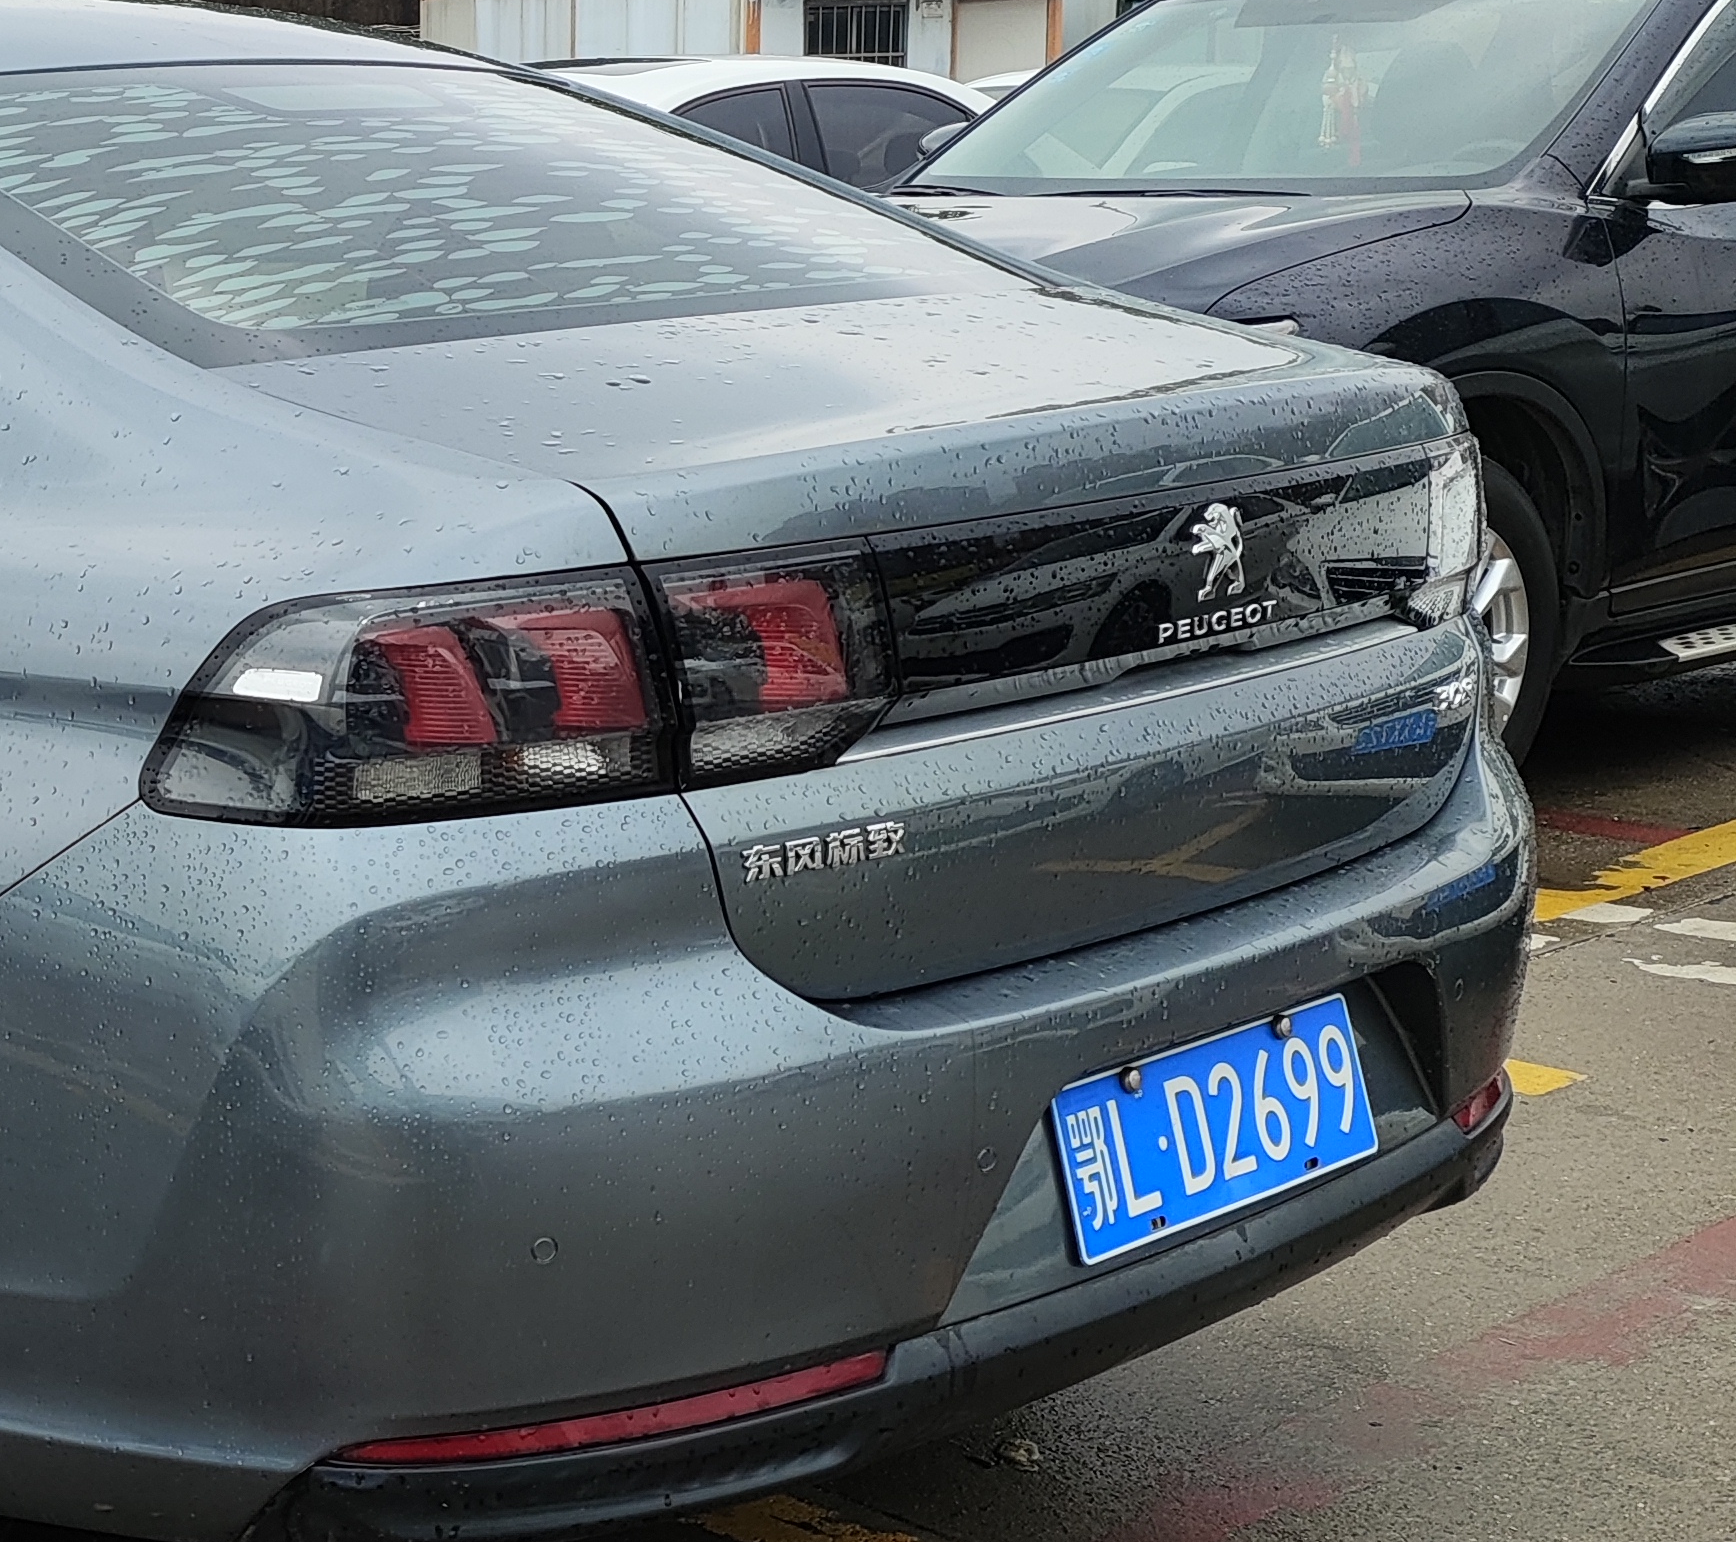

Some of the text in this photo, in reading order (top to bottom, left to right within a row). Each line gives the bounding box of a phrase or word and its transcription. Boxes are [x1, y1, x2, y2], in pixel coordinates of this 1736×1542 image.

[1158, 600, 1278, 644] PEUGEOT
[741, 821, 906, 884] 东风标致
